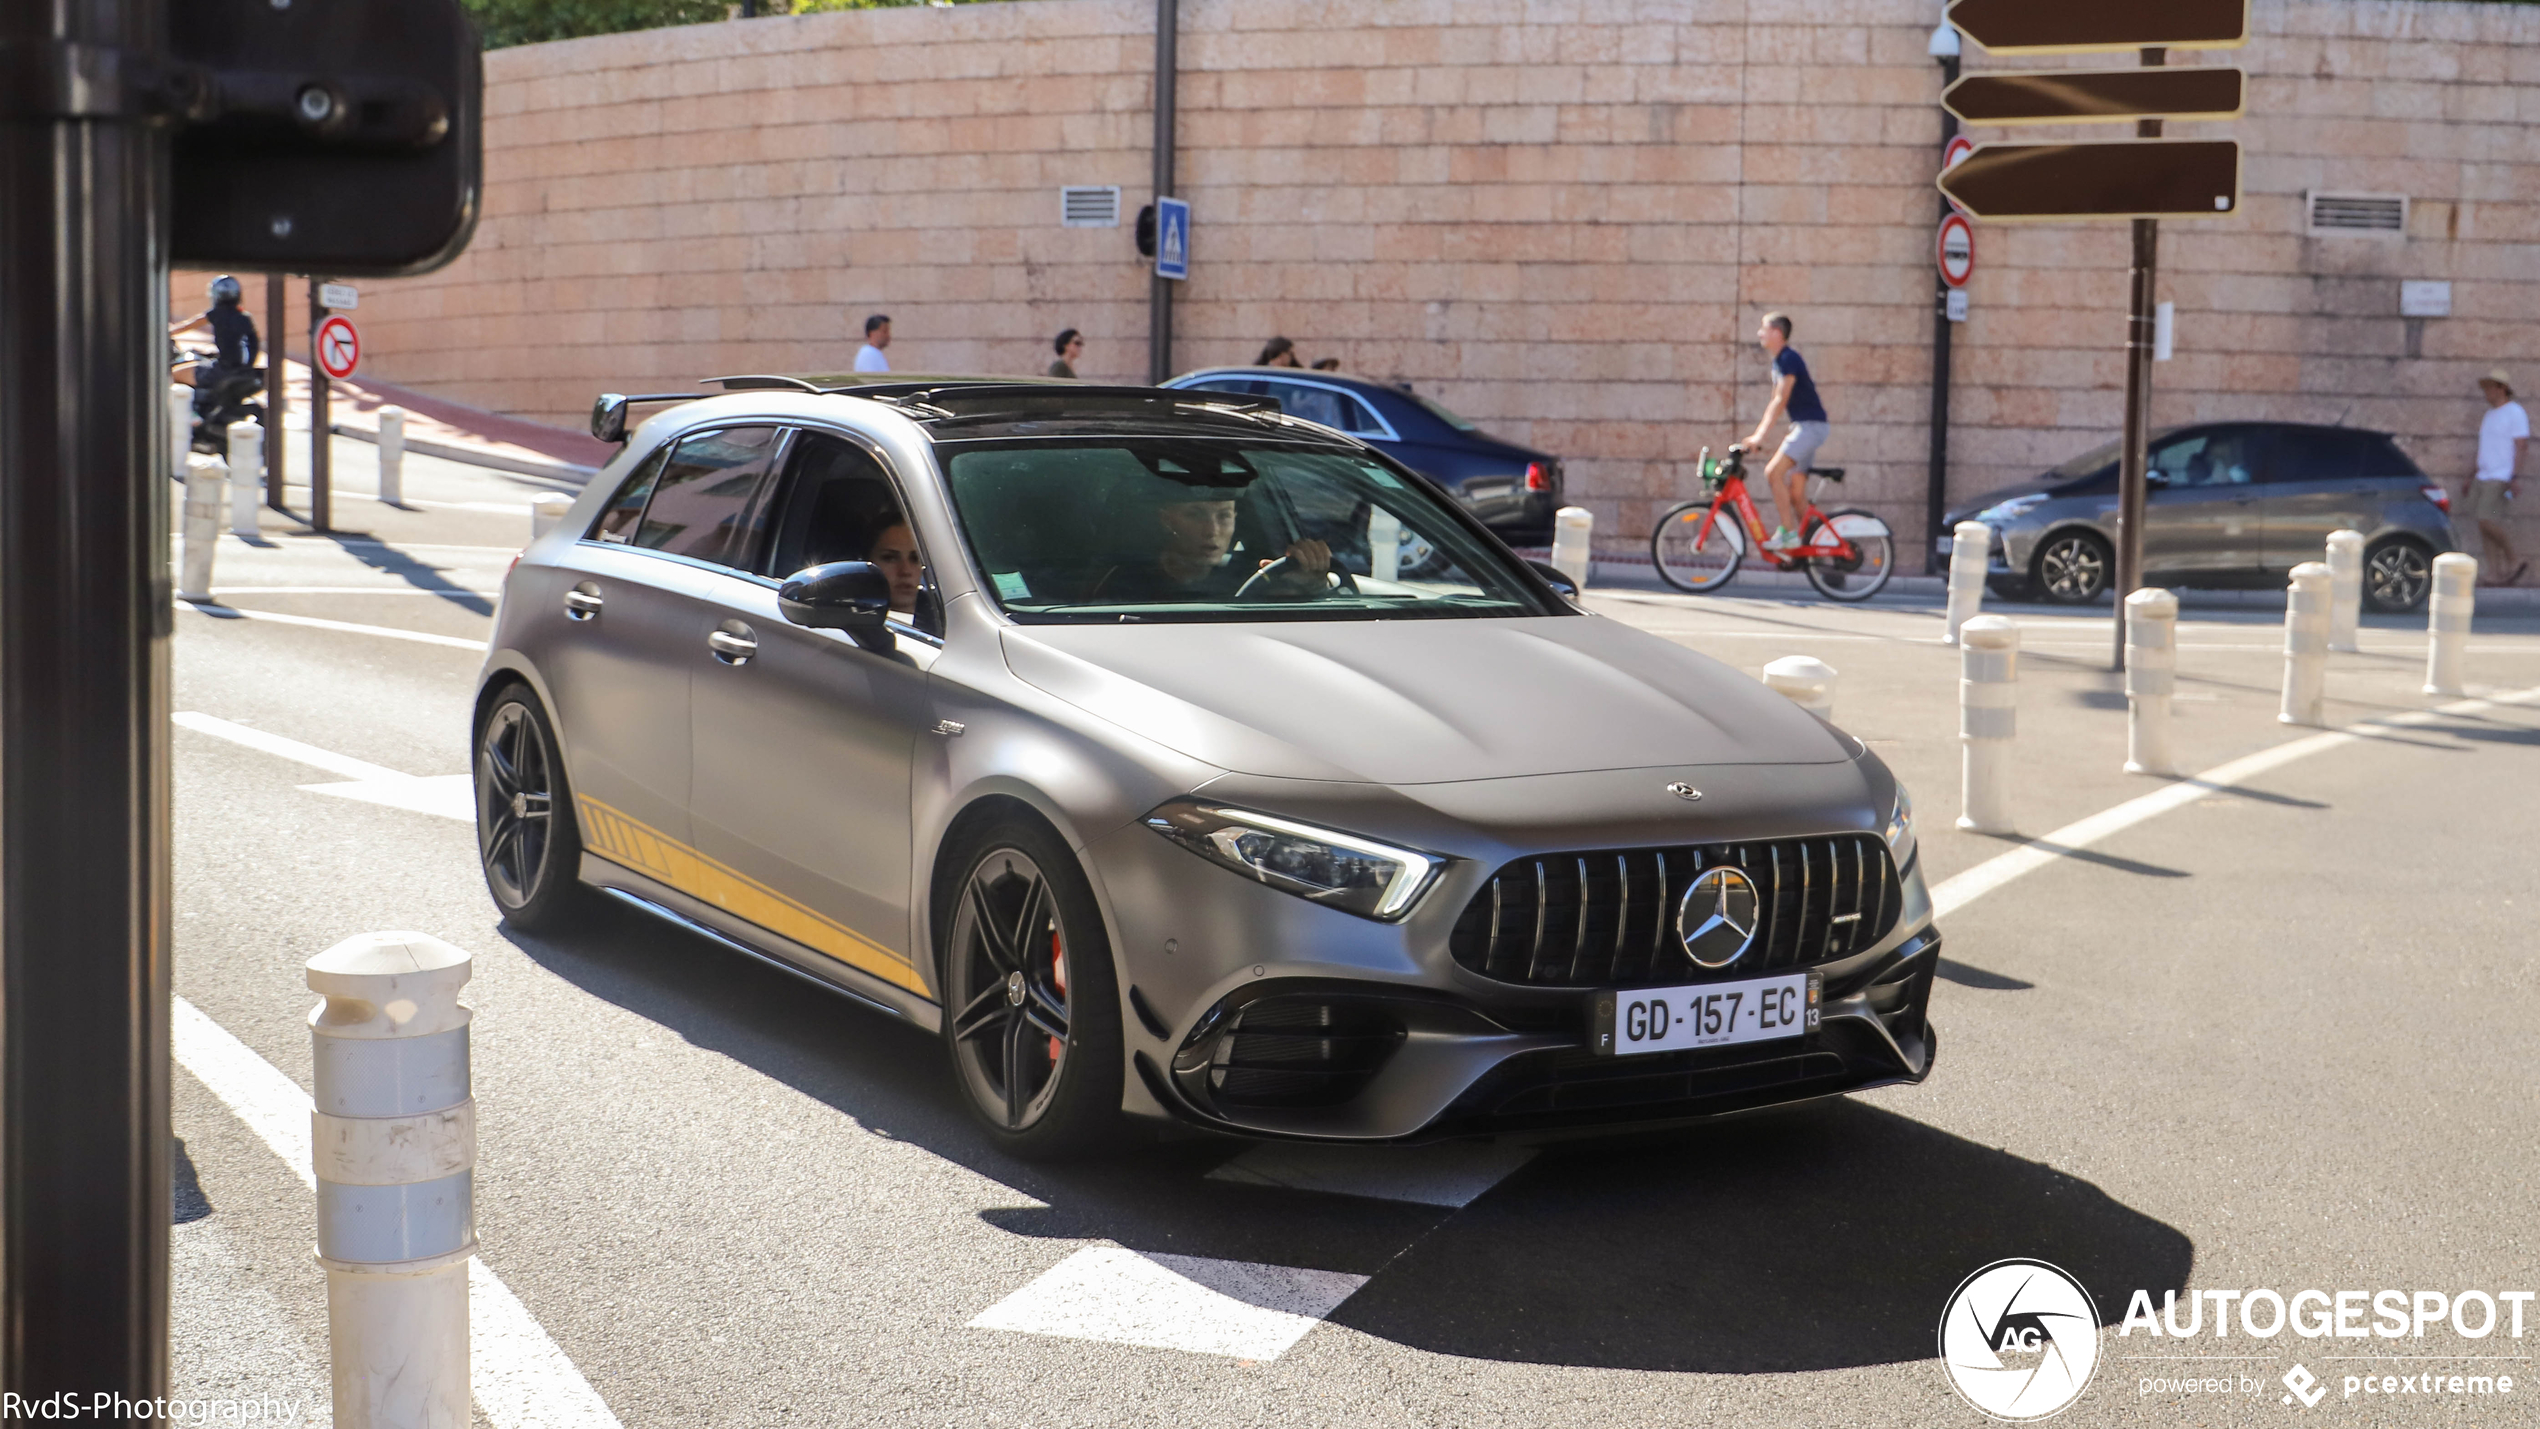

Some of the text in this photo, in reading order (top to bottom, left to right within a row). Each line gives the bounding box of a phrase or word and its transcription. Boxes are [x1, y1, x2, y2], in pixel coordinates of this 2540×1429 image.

[1626, 985, 1797, 1042] GD-157-EC
[1806, 1008, 1820, 1026] 13
[1601, 1033, 1609, 1047] F
